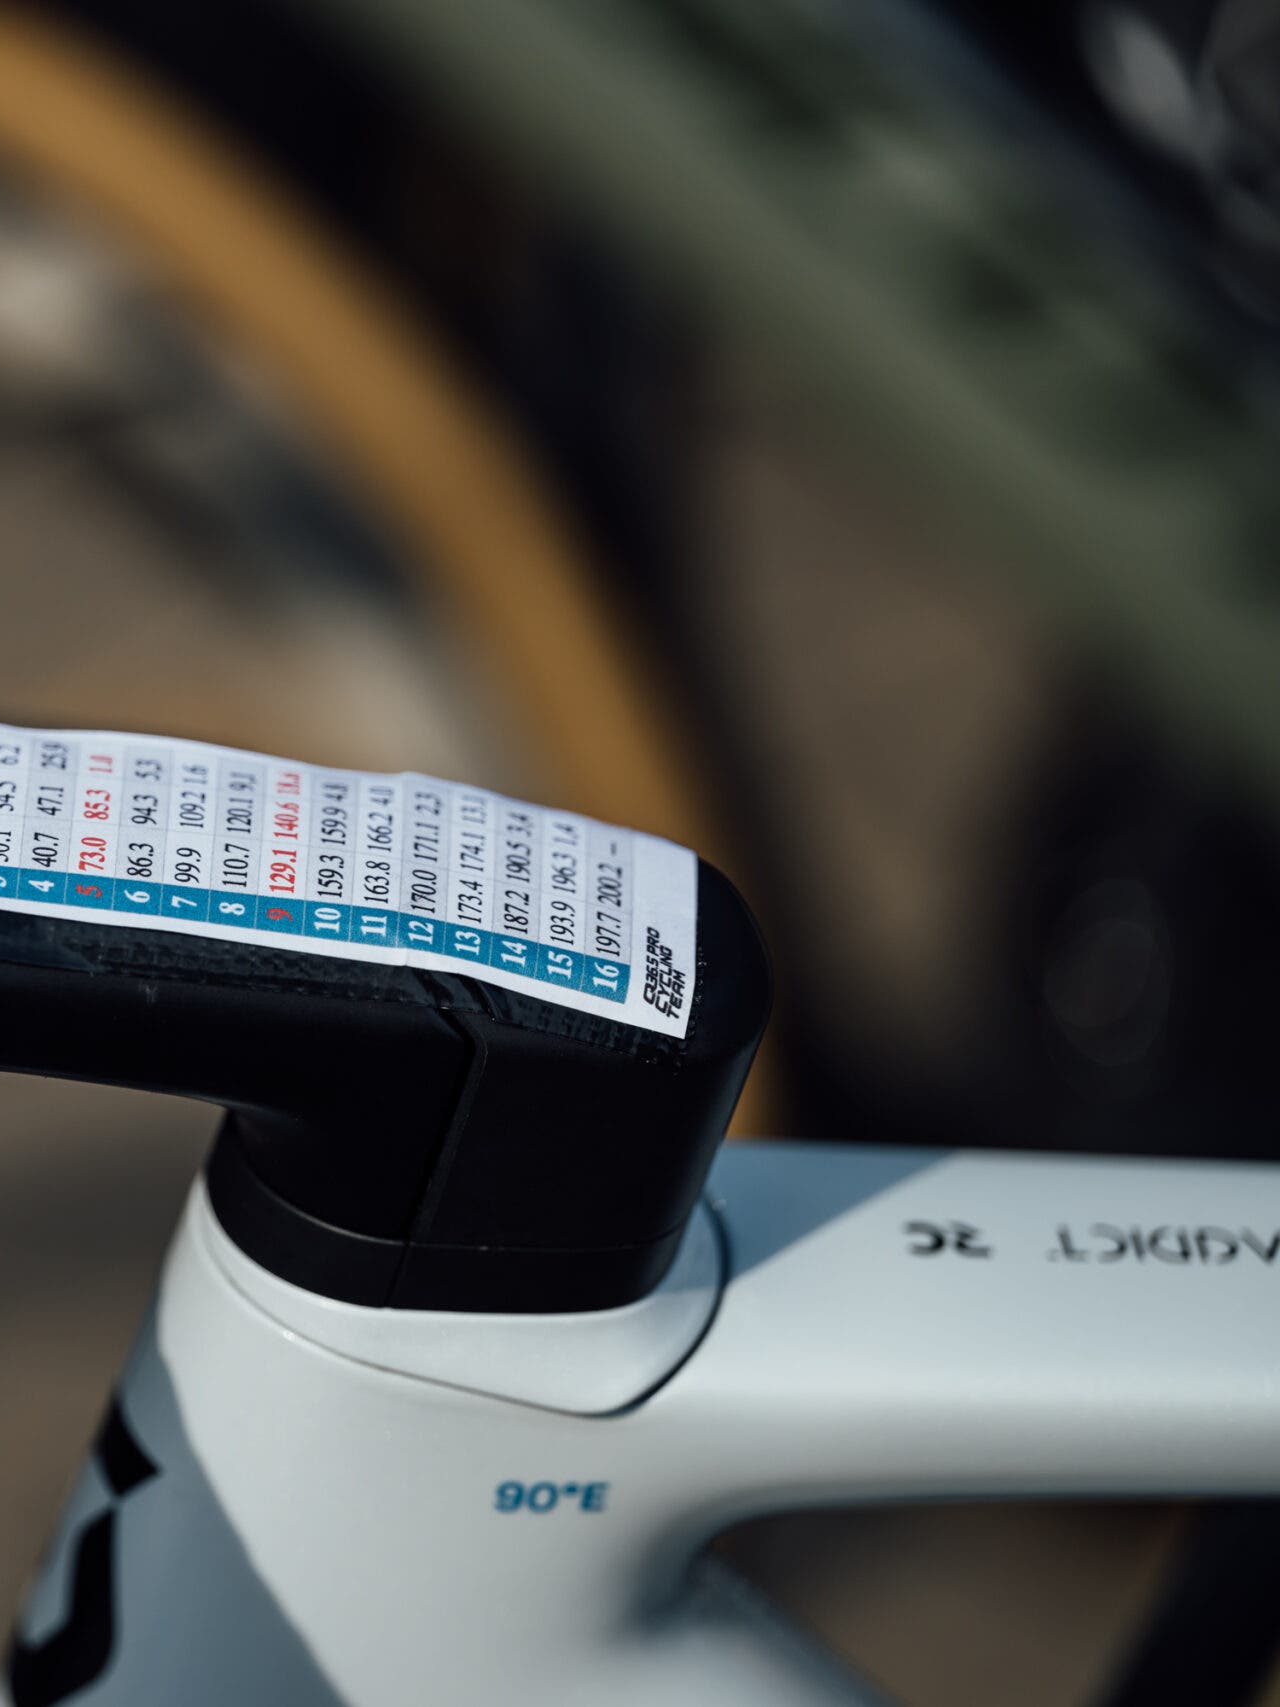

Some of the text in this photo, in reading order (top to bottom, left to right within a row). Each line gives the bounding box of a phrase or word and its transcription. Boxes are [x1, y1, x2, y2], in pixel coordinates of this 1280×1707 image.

[37, 784, 65, 817] 47.1
[84, 788, 111, 821] 85.3
[132, 792, 159, 826] 94.3
[179, 790, 207, 830] 109.2
[226, 796, 253, 837] 120.1
[274, 800, 300, 841] 140.6
[321, 806, 349, 845] 159.9
[368, 811, 395, 854] 166.2
[32, 831, 61, 869] 40.7
[78, 836, 108, 872] 73.0
[126, 842, 155, 879] 86.3
[415, 821, 441, 863] 171.1
[460, 831, 487, 872] 174.1
[507, 840, 533, 883] 190.5
[174, 846, 202, 885] 99.9
[222, 843, 249, 889] 110.7
[269, 847, 297, 895] 129.1
[317, 854, 345, 898] 159.3
[364, 859, 391, 904] 163.8
[552, 852, 579, 896] 196.3
[28, 878, 55, 893] 4
[75, 884, 103, 899] 5
[123, 890, 151, 904] 6
[171, 895, 197, 909] 7
[411, 869, 437, 914] 170.0
[457, 879, 483, 925] 173.4
[219, 901, 246, 916] 8
[266, 908, 293, 923] 9
[314, 907, 341, 933] 10
[361, 914, 387, 937] 11
[504, 890, 530, 935] 187.2
[550, 900, 576, 946] 193.9
[592, 864, 624, 991] 16 197.7 200.2
[408, 918, 435, 945] 12
[454, 929, 481, 956] 13
[646, 927, 661, 956] PRO
[501, 940, 526, 967] 14
[547, 951, 573, 980] 15
[654, 945, 673, 1014] CYCLING
[666, 970, 686, 1019] TEAM
[904, 1220, 993, 1259] RC
